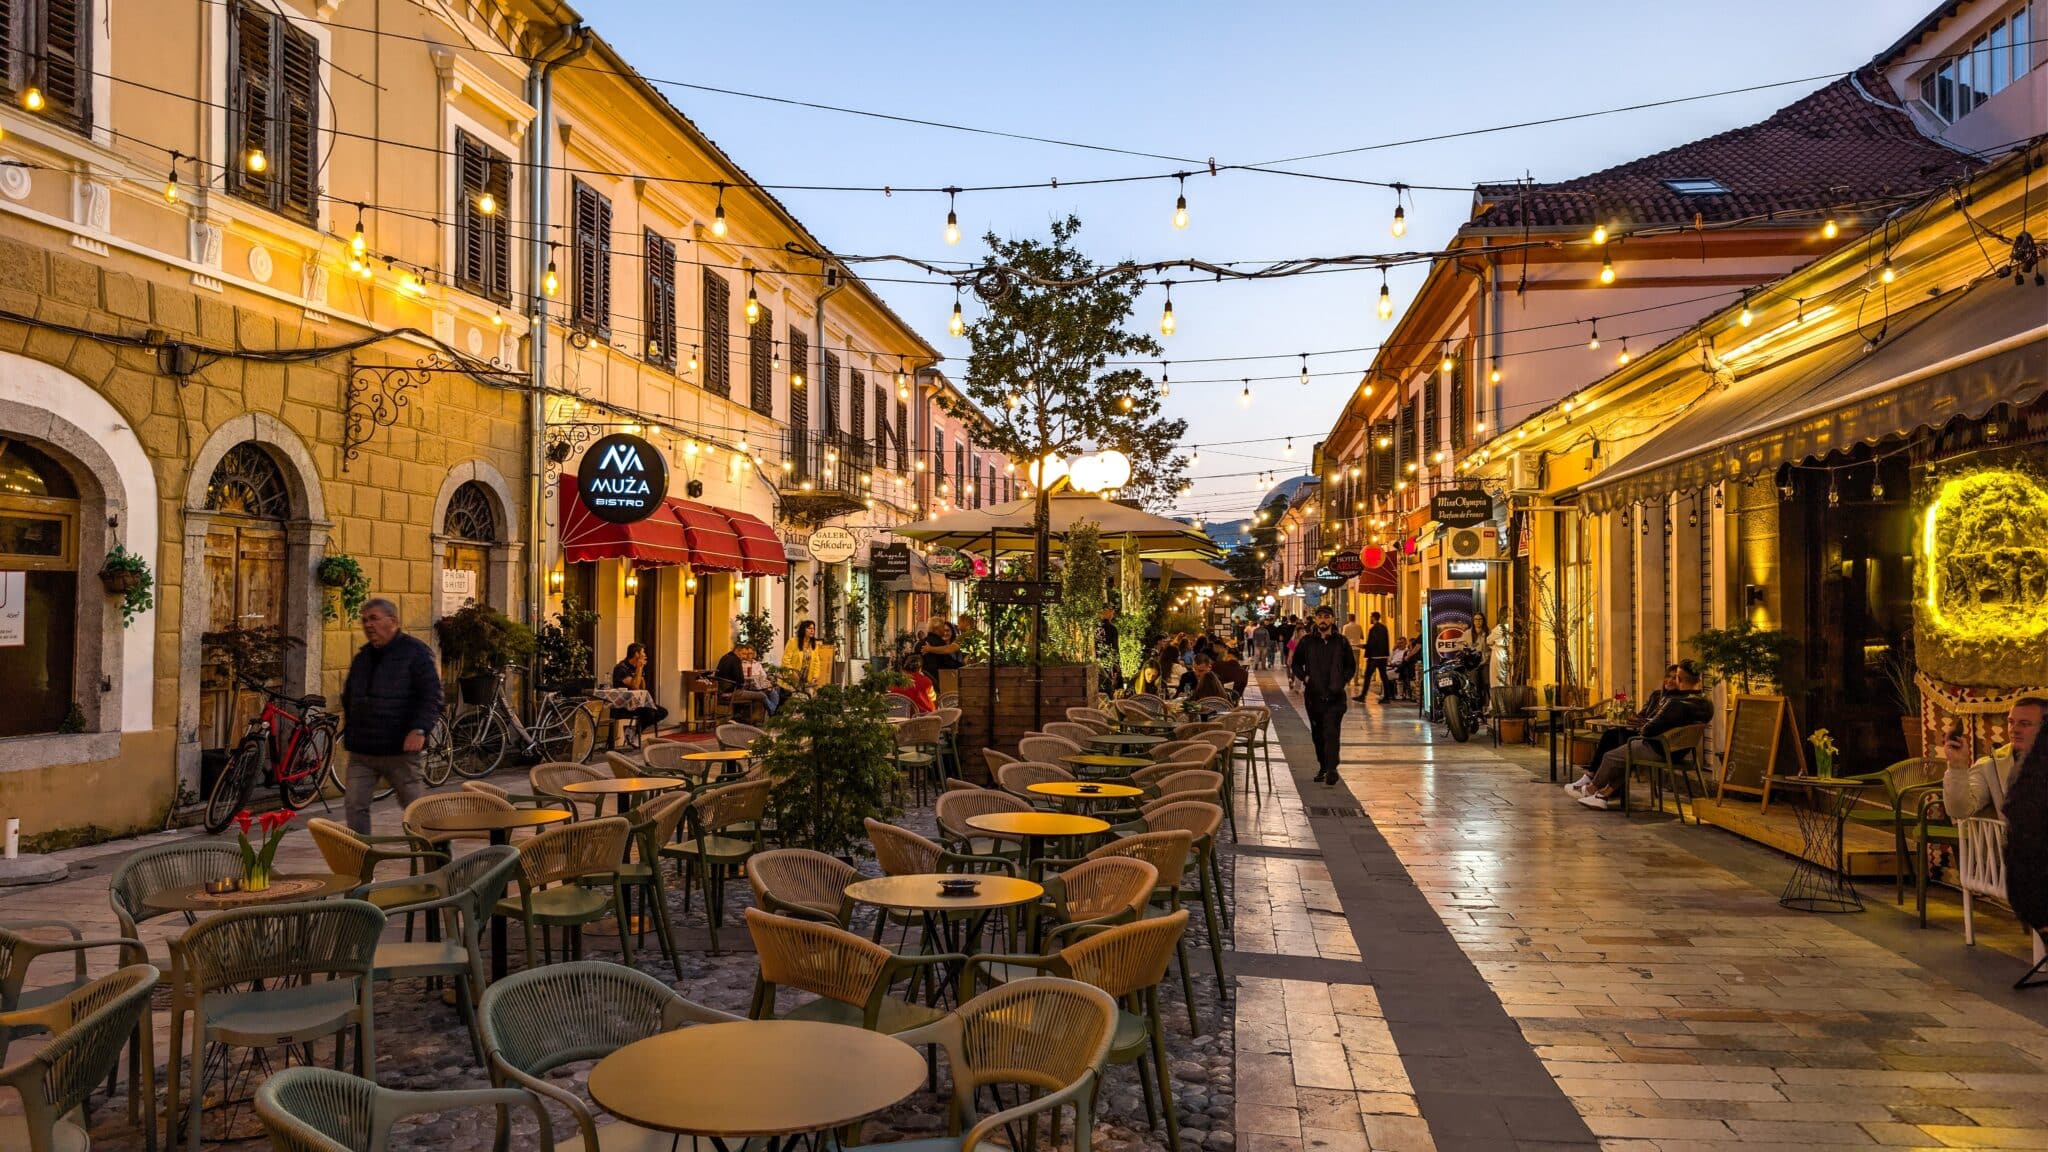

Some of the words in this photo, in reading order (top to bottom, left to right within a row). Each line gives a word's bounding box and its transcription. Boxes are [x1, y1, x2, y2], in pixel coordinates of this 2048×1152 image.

[591, 476, 650, 494] MUŻA
[595, 498, 645, 507] BISTRO
[785, 534, 809, 545] GALER
[816, 531, 848, 539] GALERI
[811, 540, 852, 552] Shkodra
